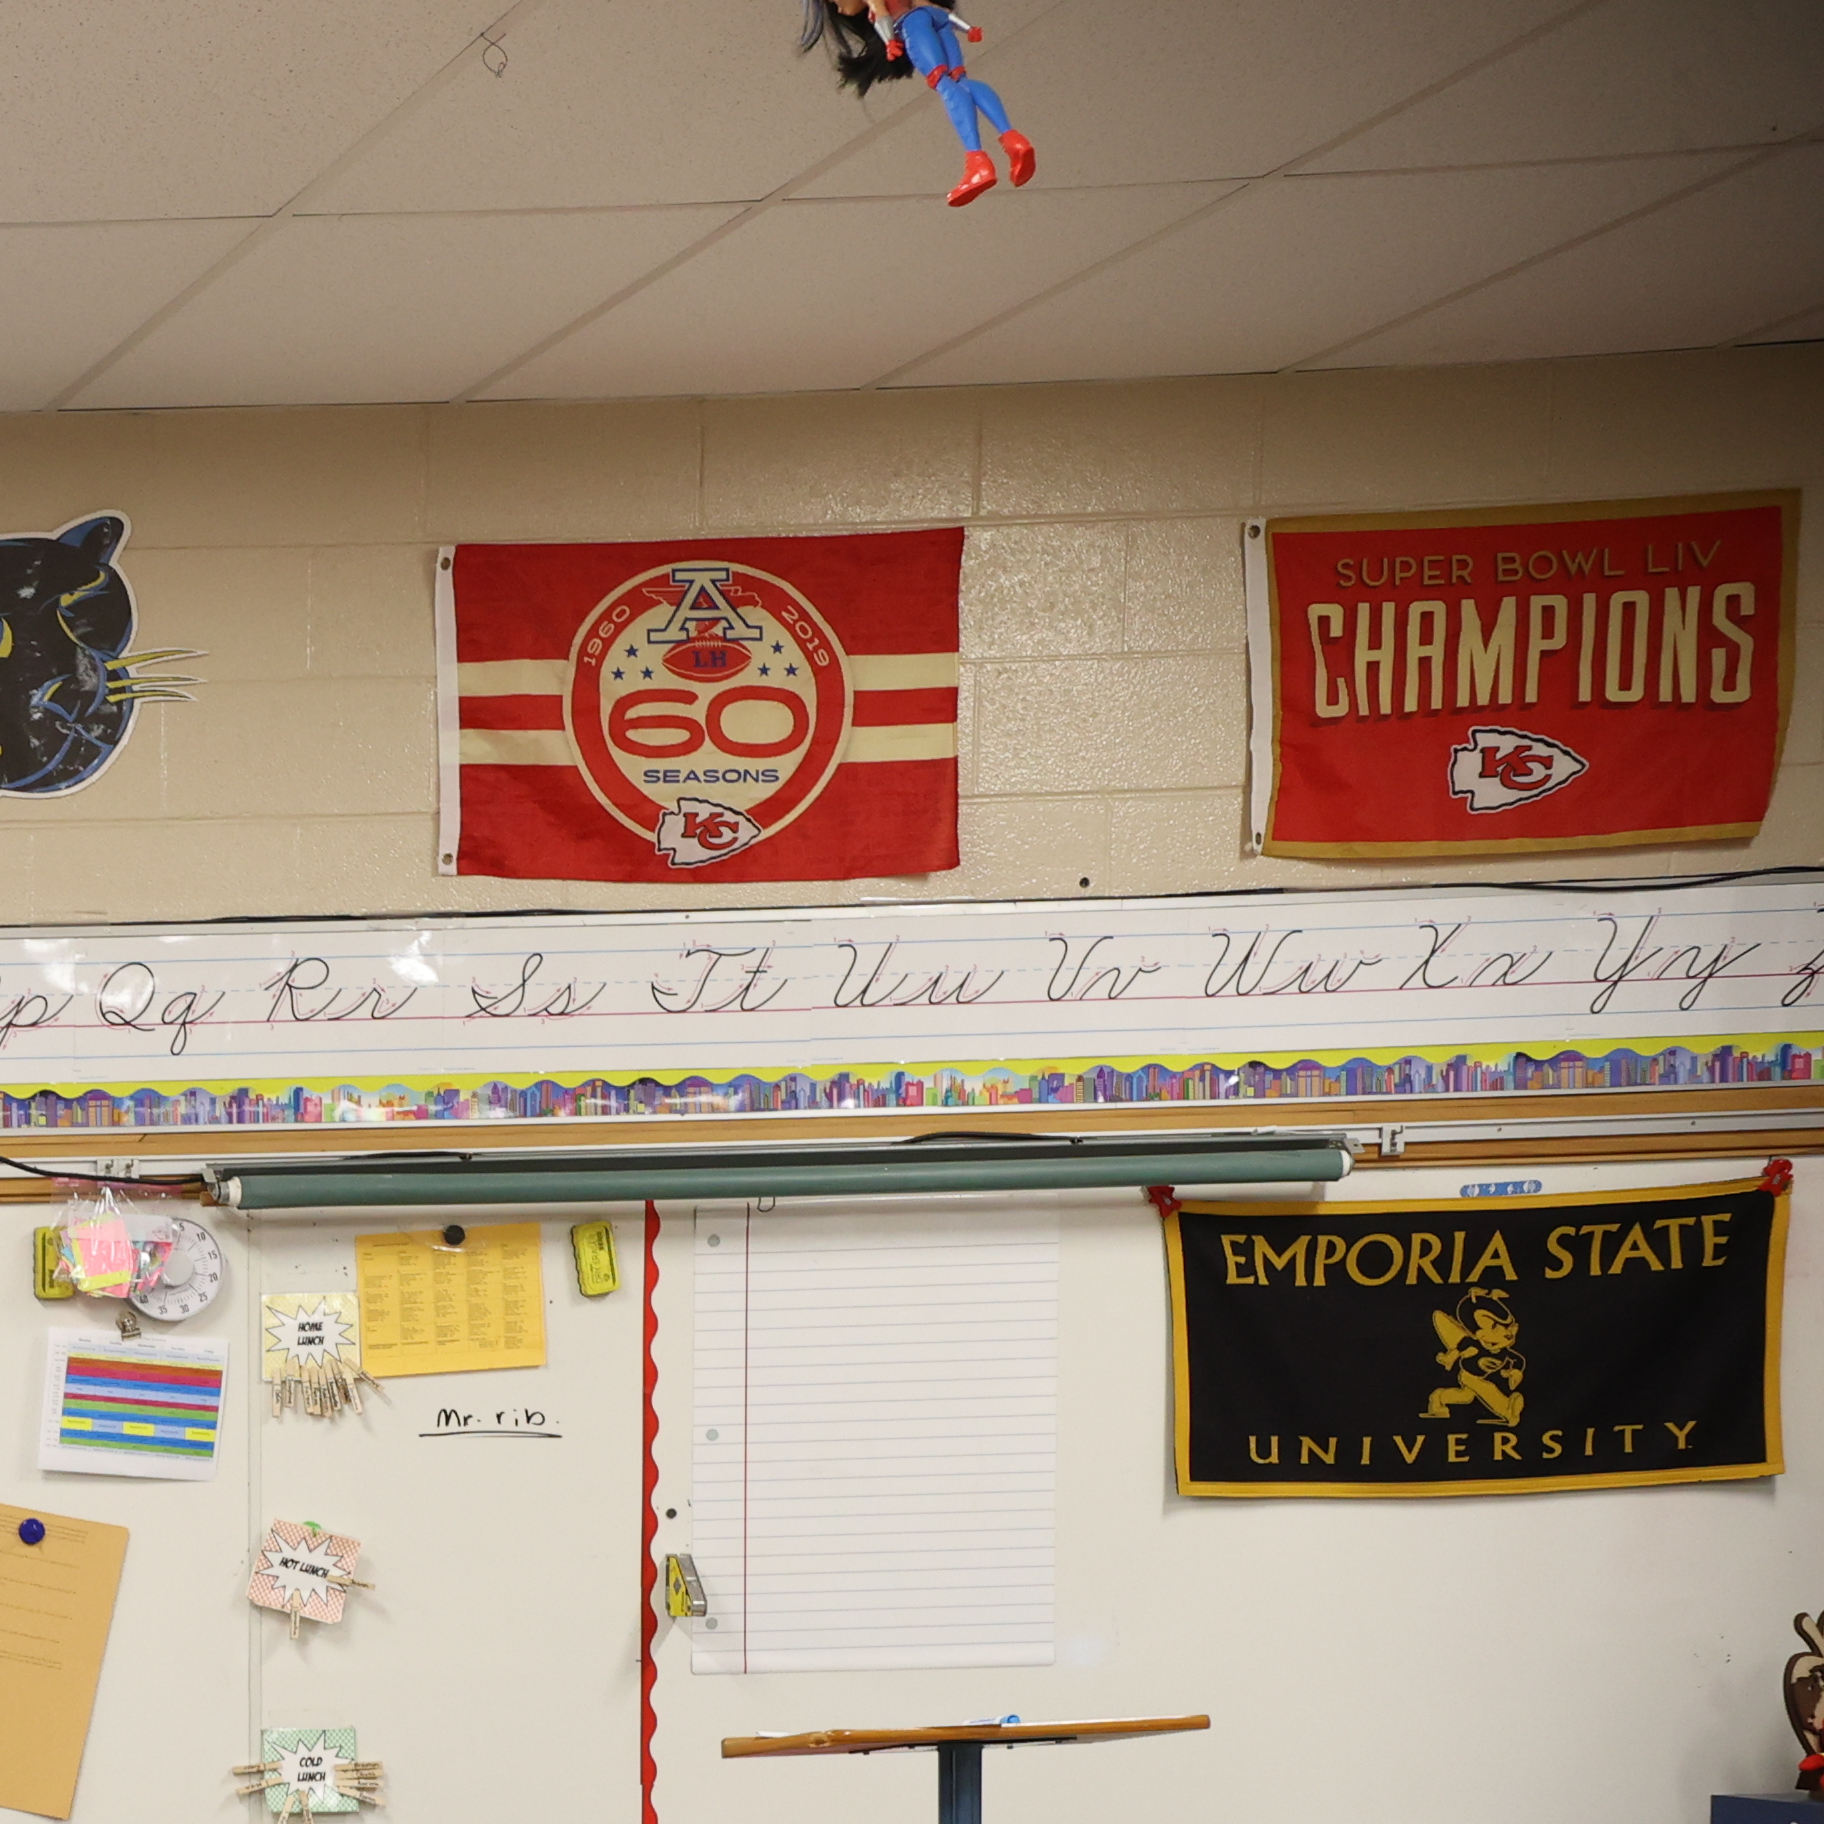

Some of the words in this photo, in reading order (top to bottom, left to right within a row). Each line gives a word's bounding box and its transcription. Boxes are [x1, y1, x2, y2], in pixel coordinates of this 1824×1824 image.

[1336, 554, 1473, 591] SUPER
[1497, 547, 1624, 582] BOWL
[1646, 539, 1722, 574] LIV
[583, 604, 630, 668] 1960
[781, 605, 829, 669] 2019
[1307, 581, 1755, 719] CHAMPIONS
[692, 649, 727, 669] LH
[608, 685, 810, 759] 60
[643, 768, 779, 784] SEASONS
[179, 1223, 185, 1232] 5
[196, 1231, 206, 1242] 10
[207, 1251, 217, 1260] 15
[1219, 1229, 1519, 1287] EMPORIA
[1544, 1213, 1732, 1282] STATE
[208, 1273, 218, 1282] 20
[199, 1292, 208, 1302] 25
[158, 1305, 168, 1314] 35
[180, 1304, 189, 1314] 30
[298, 1322, 323, 1331] HOME
[297, 1336, 324, 1346] LUNCH
[436, 1408, 481, 1428] Mr.
[1249, 1419, 1698, 1465] UNIVERSITY
[279, 1557, 299, 1570] HOT
[300, 1562, 329, 1579] LUNCH
[300, 1757, 323, 1767] COLD
[298, 1771, 326, 1782] LUNCH
